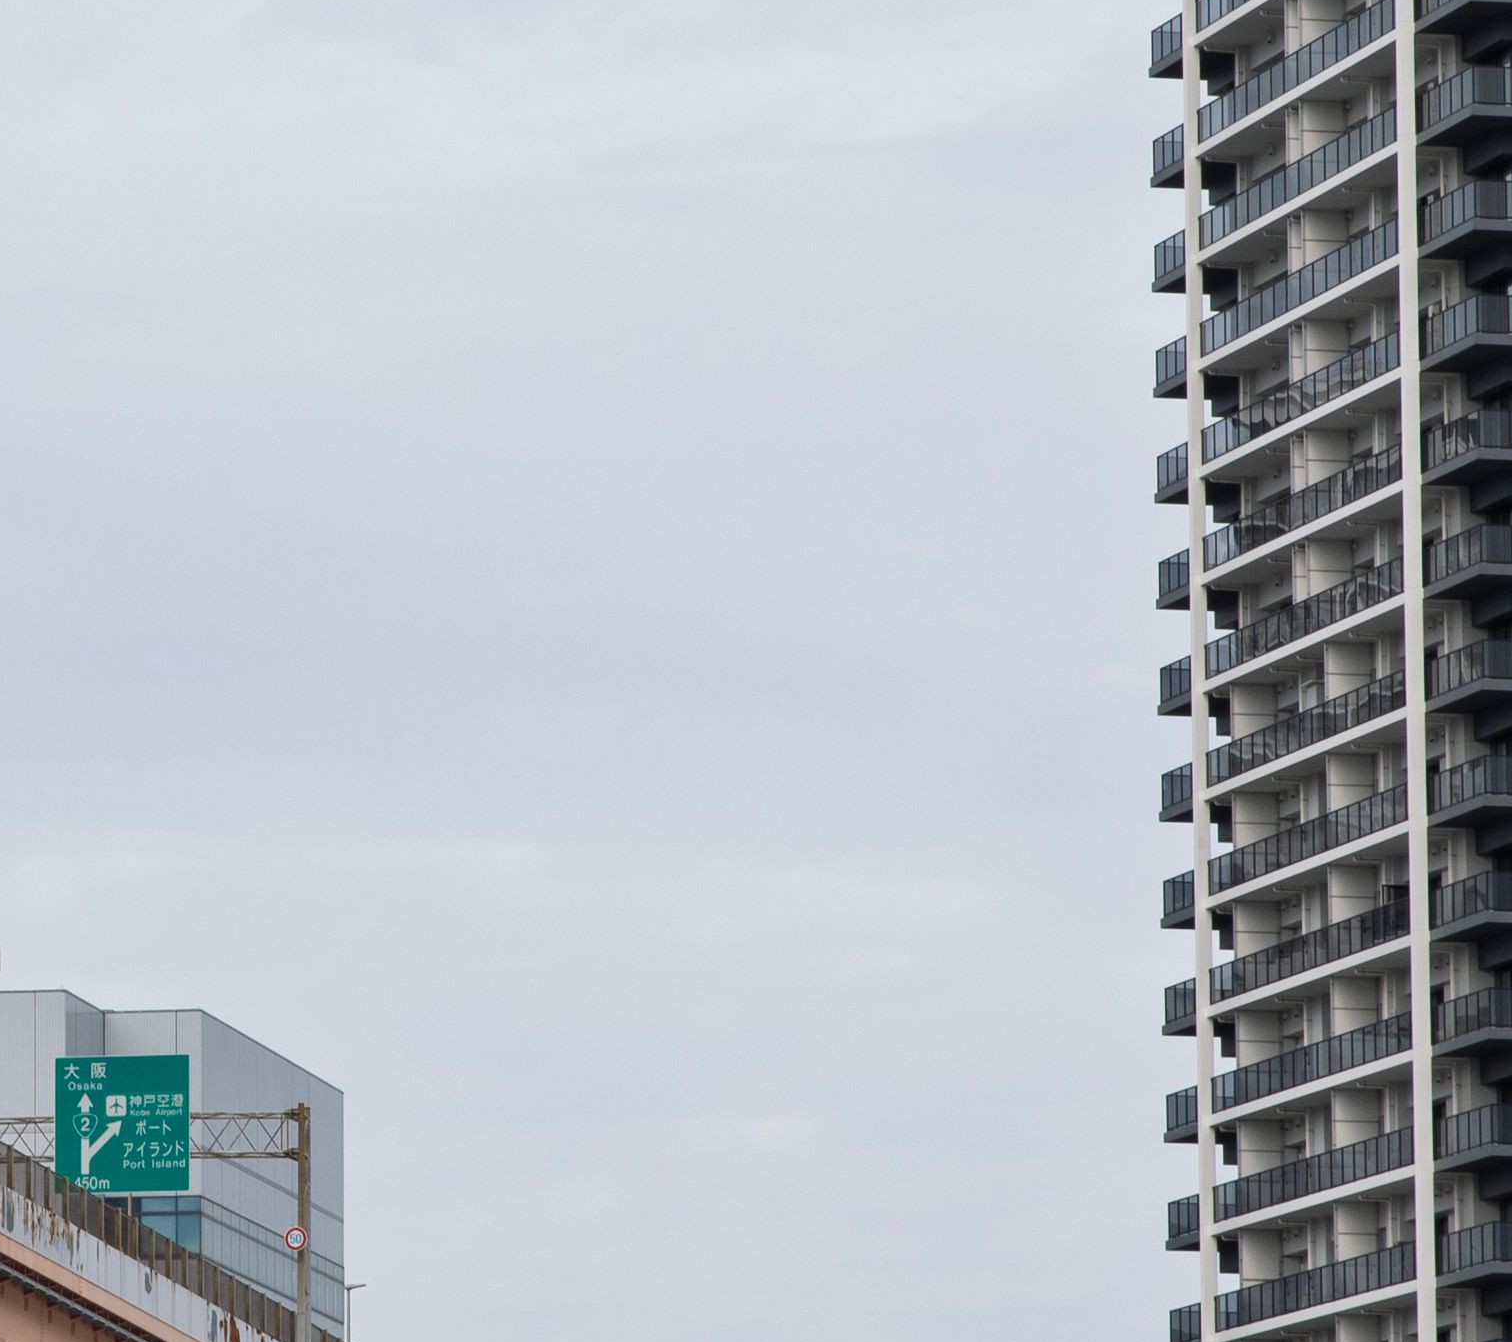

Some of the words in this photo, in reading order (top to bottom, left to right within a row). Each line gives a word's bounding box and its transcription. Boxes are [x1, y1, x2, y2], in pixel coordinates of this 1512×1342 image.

[64, 1062, 106, 1079] 大阪
[68, 1081, 103, 1091] Osaka
[129, 1093, 183, 1108] 神戸空港
[156, 1108, 182, 1117] Airport
[80, 1117, 90, 1131] 2
[136, 1119, 172, 1136] ポート
[123, 1140, 184, 1157] アイランド
[123, 1159, 145, 1169] Port
[152, 1158, 186, 1168] Island
[75, 1176, 110, 1190] 450m
[290, 1232, 302, 1244] 50
